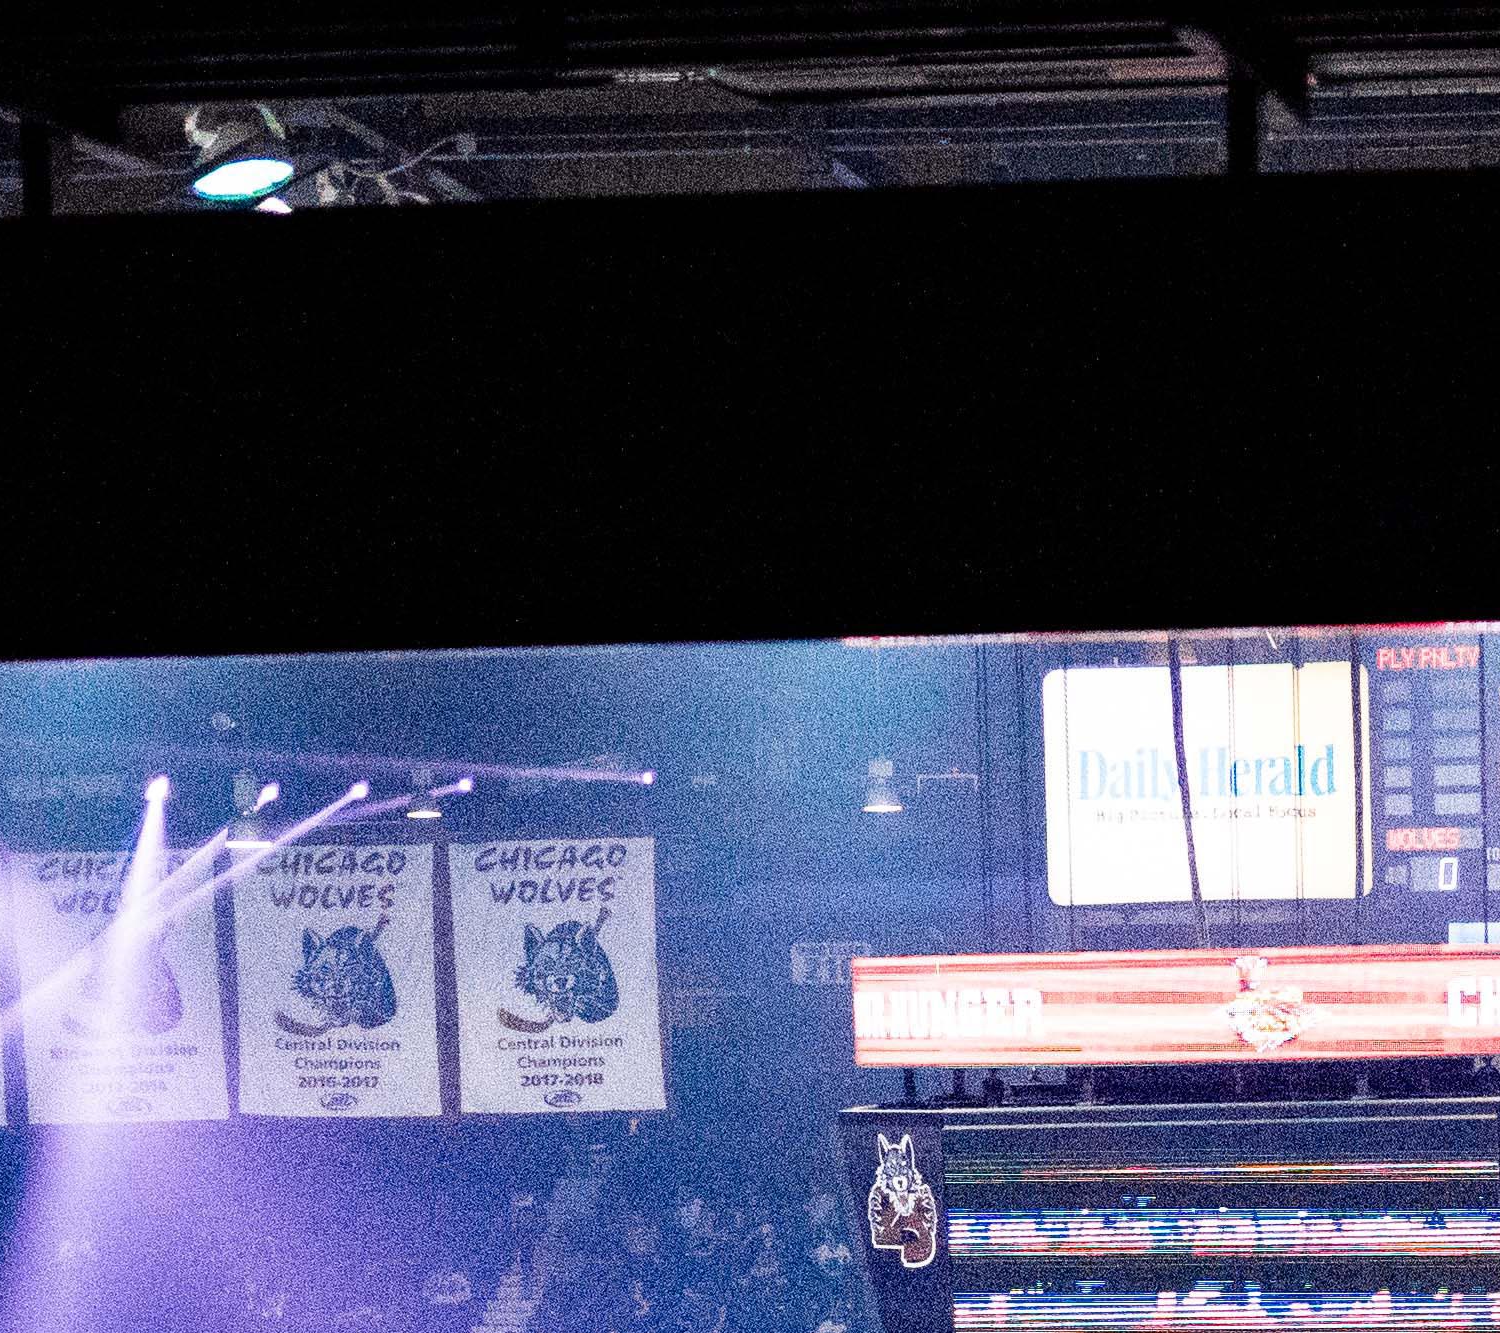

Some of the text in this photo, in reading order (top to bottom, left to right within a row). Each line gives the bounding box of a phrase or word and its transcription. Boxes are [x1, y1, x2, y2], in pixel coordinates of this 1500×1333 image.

[1376, 645, 1479, 670] PLY PNLTY
[1078, 744, 1337, 801] Daily Herald
[1386, 828, 1461, 851] WOLVES
[256, 849, 407, 877] CHICAGO
[475, 844, 628, 874] CHICAGO
[1437, 855, 1459, 891] 0
[270, 882, 396, 911] WOLVES
[490, 877, 617, 906] WOLVES
[336, 1036, 402, 1052] Division
[497, 1034, 623, 1051] Central Division
[294, 1054, 382, 1073] Champions
[516, 1052, 605, 1071] Champions
